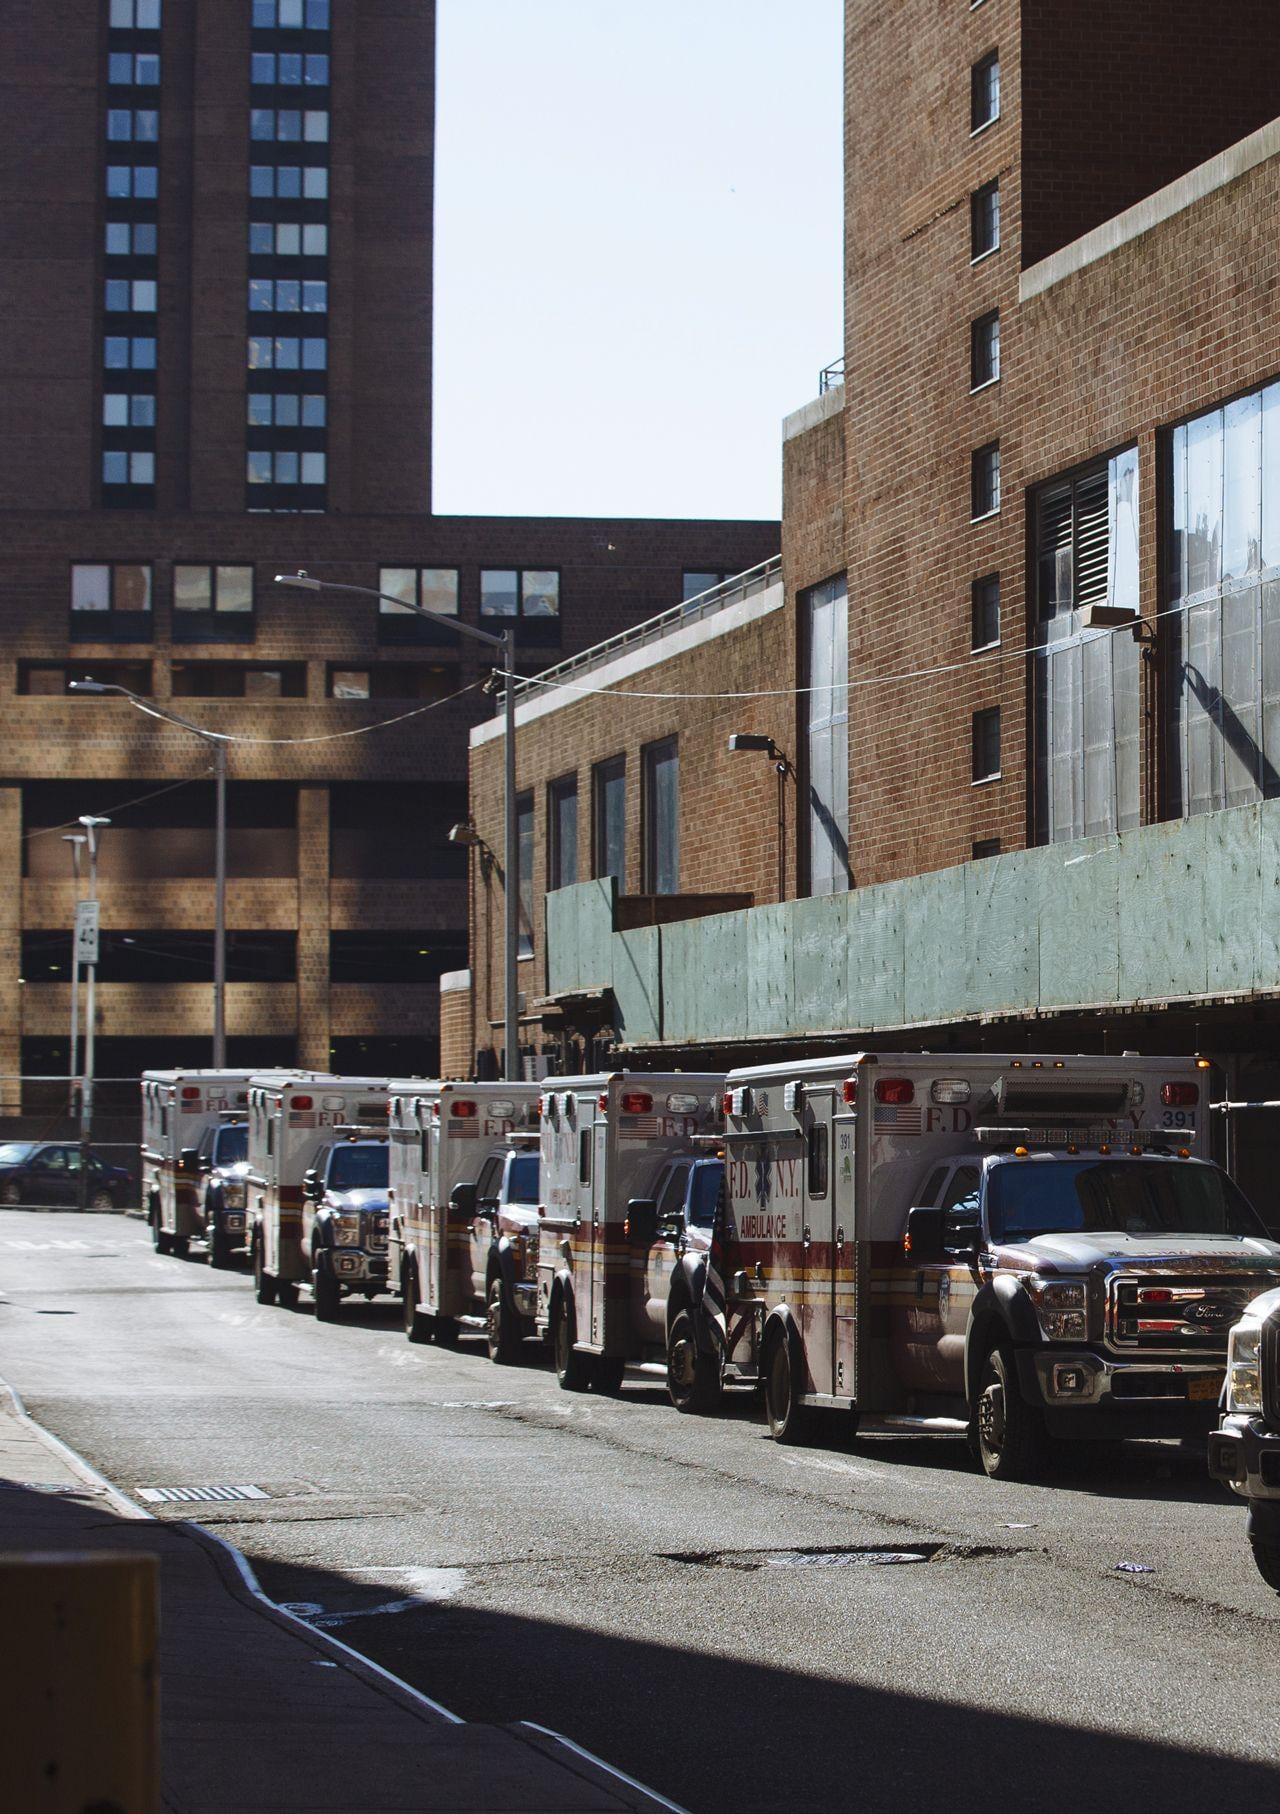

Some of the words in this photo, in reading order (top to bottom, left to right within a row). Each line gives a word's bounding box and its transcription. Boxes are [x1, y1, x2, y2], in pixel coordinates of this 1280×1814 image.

[1162, 1110, 1195, 1128] 391
[840, 1133, 850, 1150] 391
[729, 1161, 751, 1199] F.D.
[775, 1159, 799, 1198] N.Y.
[741, 1215, 787, 1239] AMBULANCE
